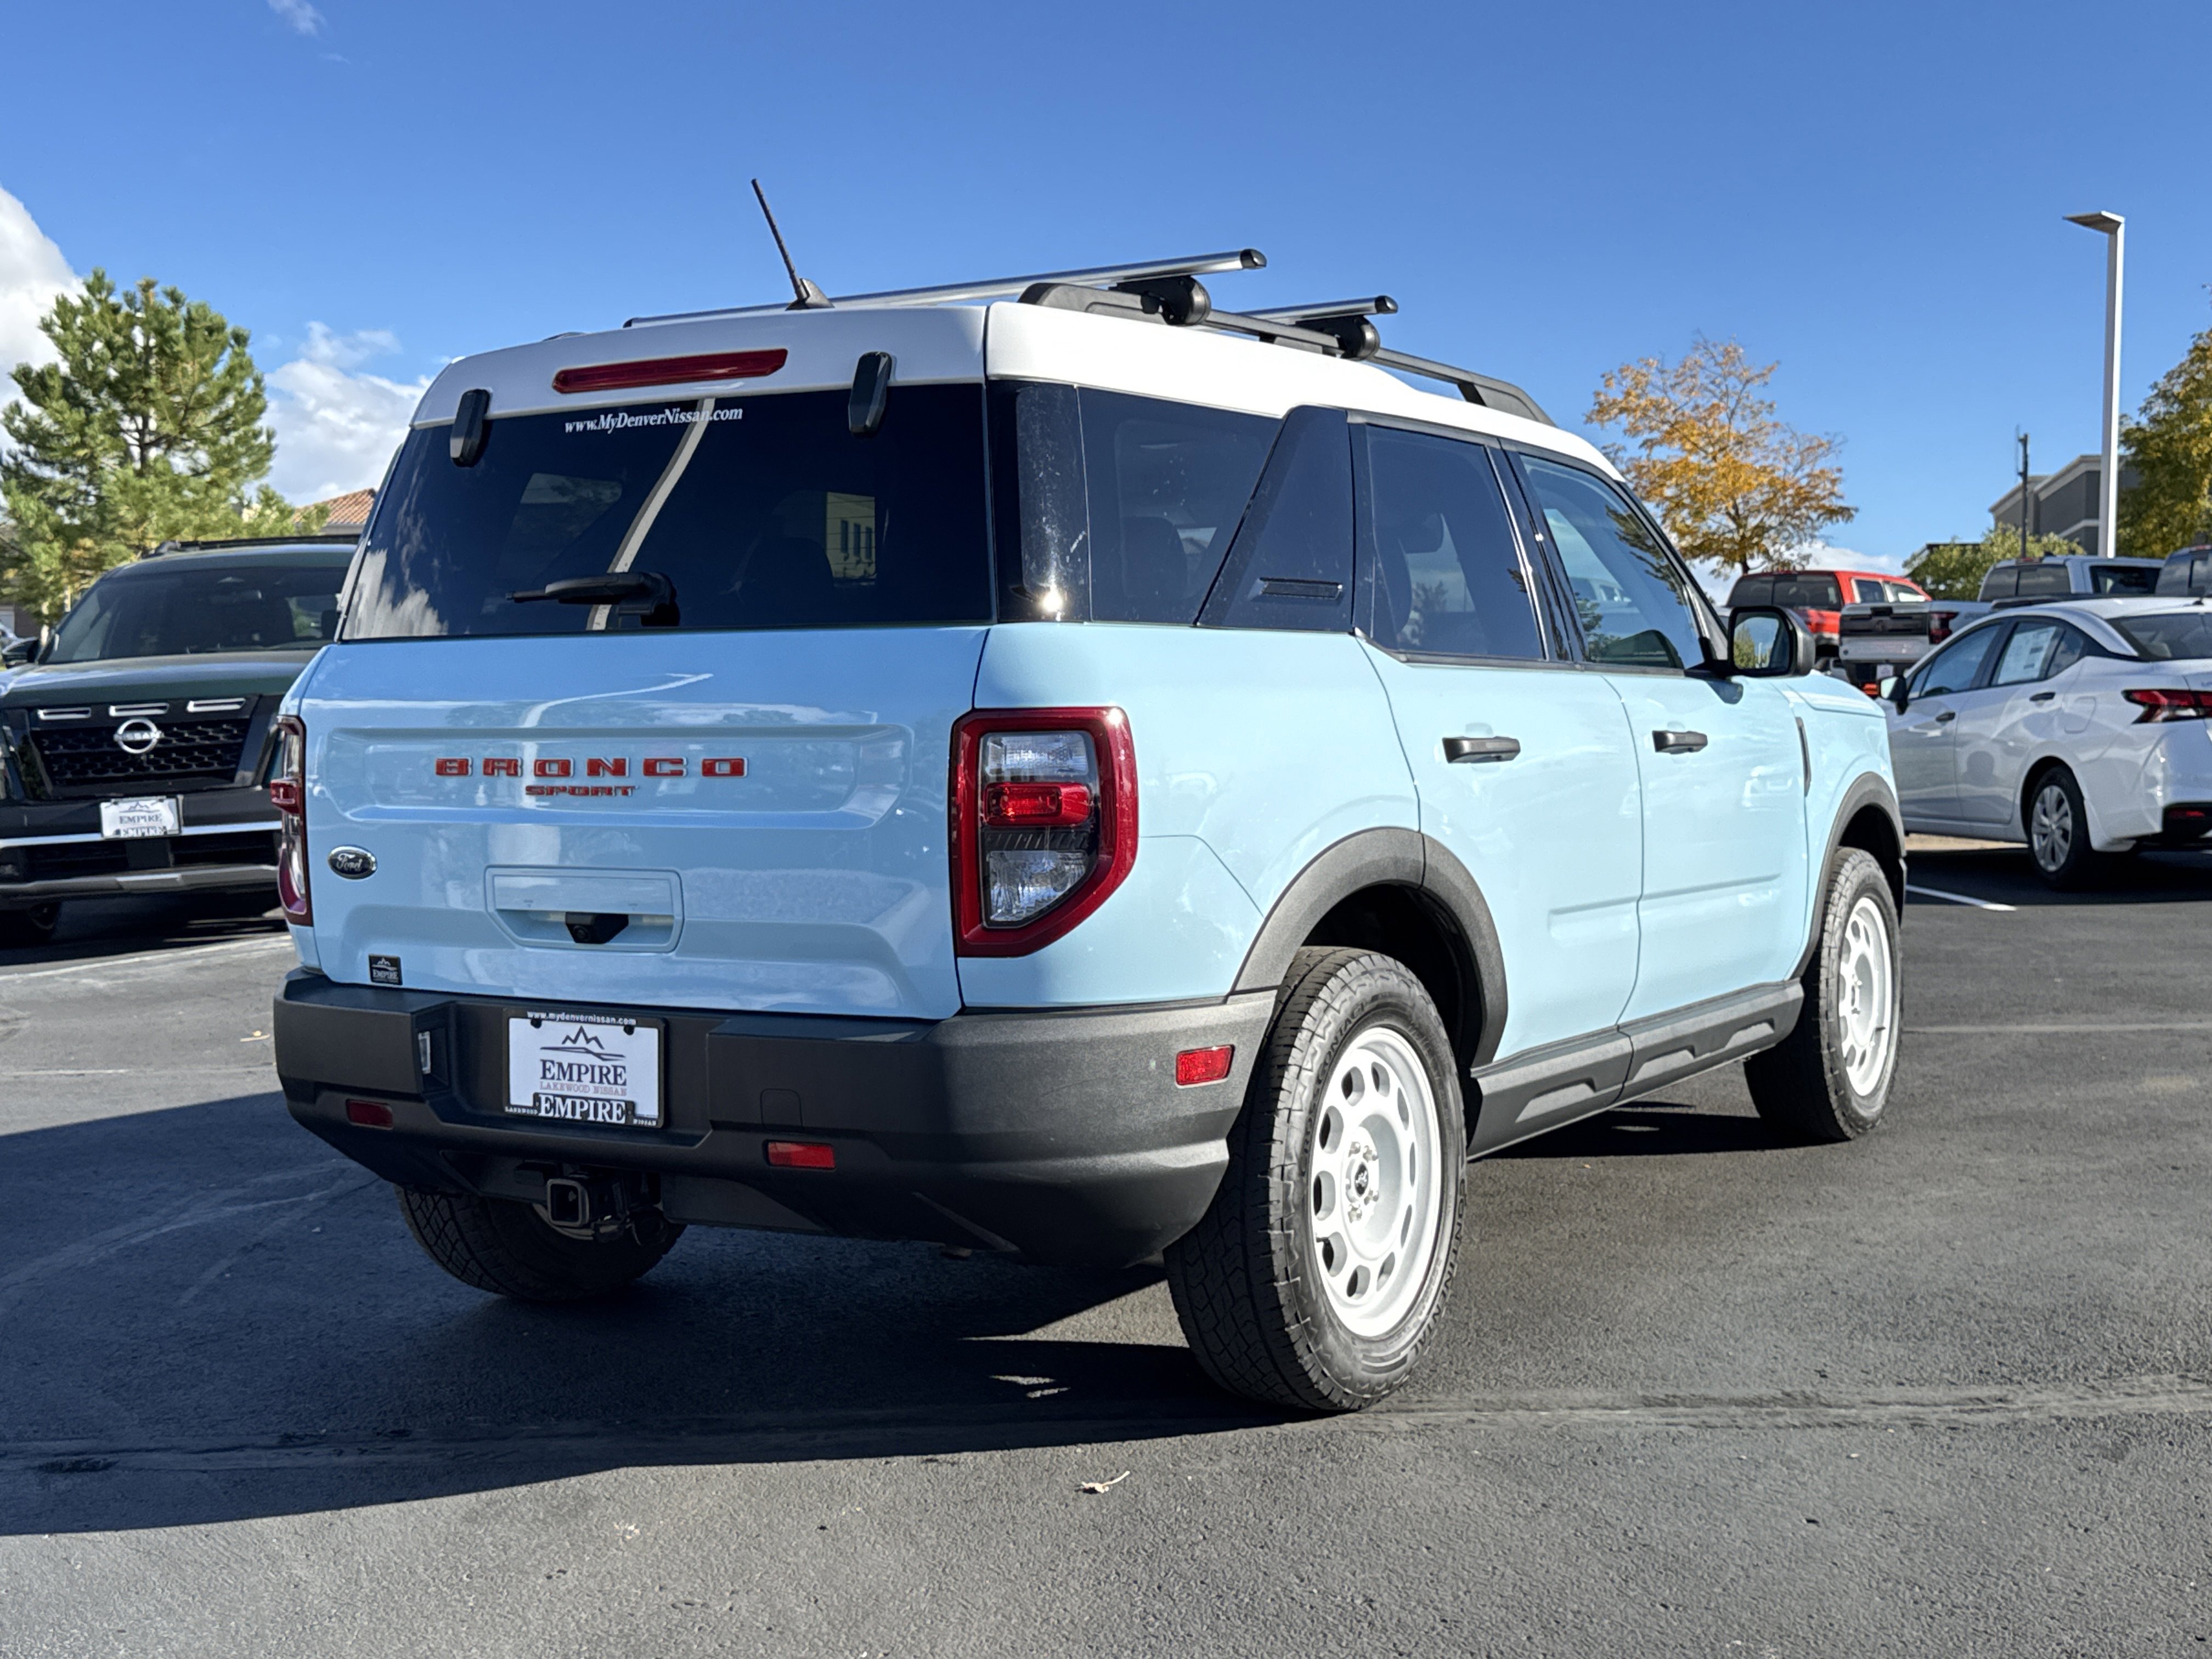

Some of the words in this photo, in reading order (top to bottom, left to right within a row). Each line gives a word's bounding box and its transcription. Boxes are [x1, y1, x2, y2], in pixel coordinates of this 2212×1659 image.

[565, 408, 743, 434] www.MyDenverNissan.com
[436, 757, 748, 777] BRONCO
[526, 785, 639, 797] SPORT
[336, 853, 363, 871] Ford
[540, 1059, 627, 1086] EMPIRE
[539, 1081, 590, 1094] LAKEWOOD
[593, 1085, 627, 1097] NISSAN
[538, 1094, 627, 1125] EMPIRE
